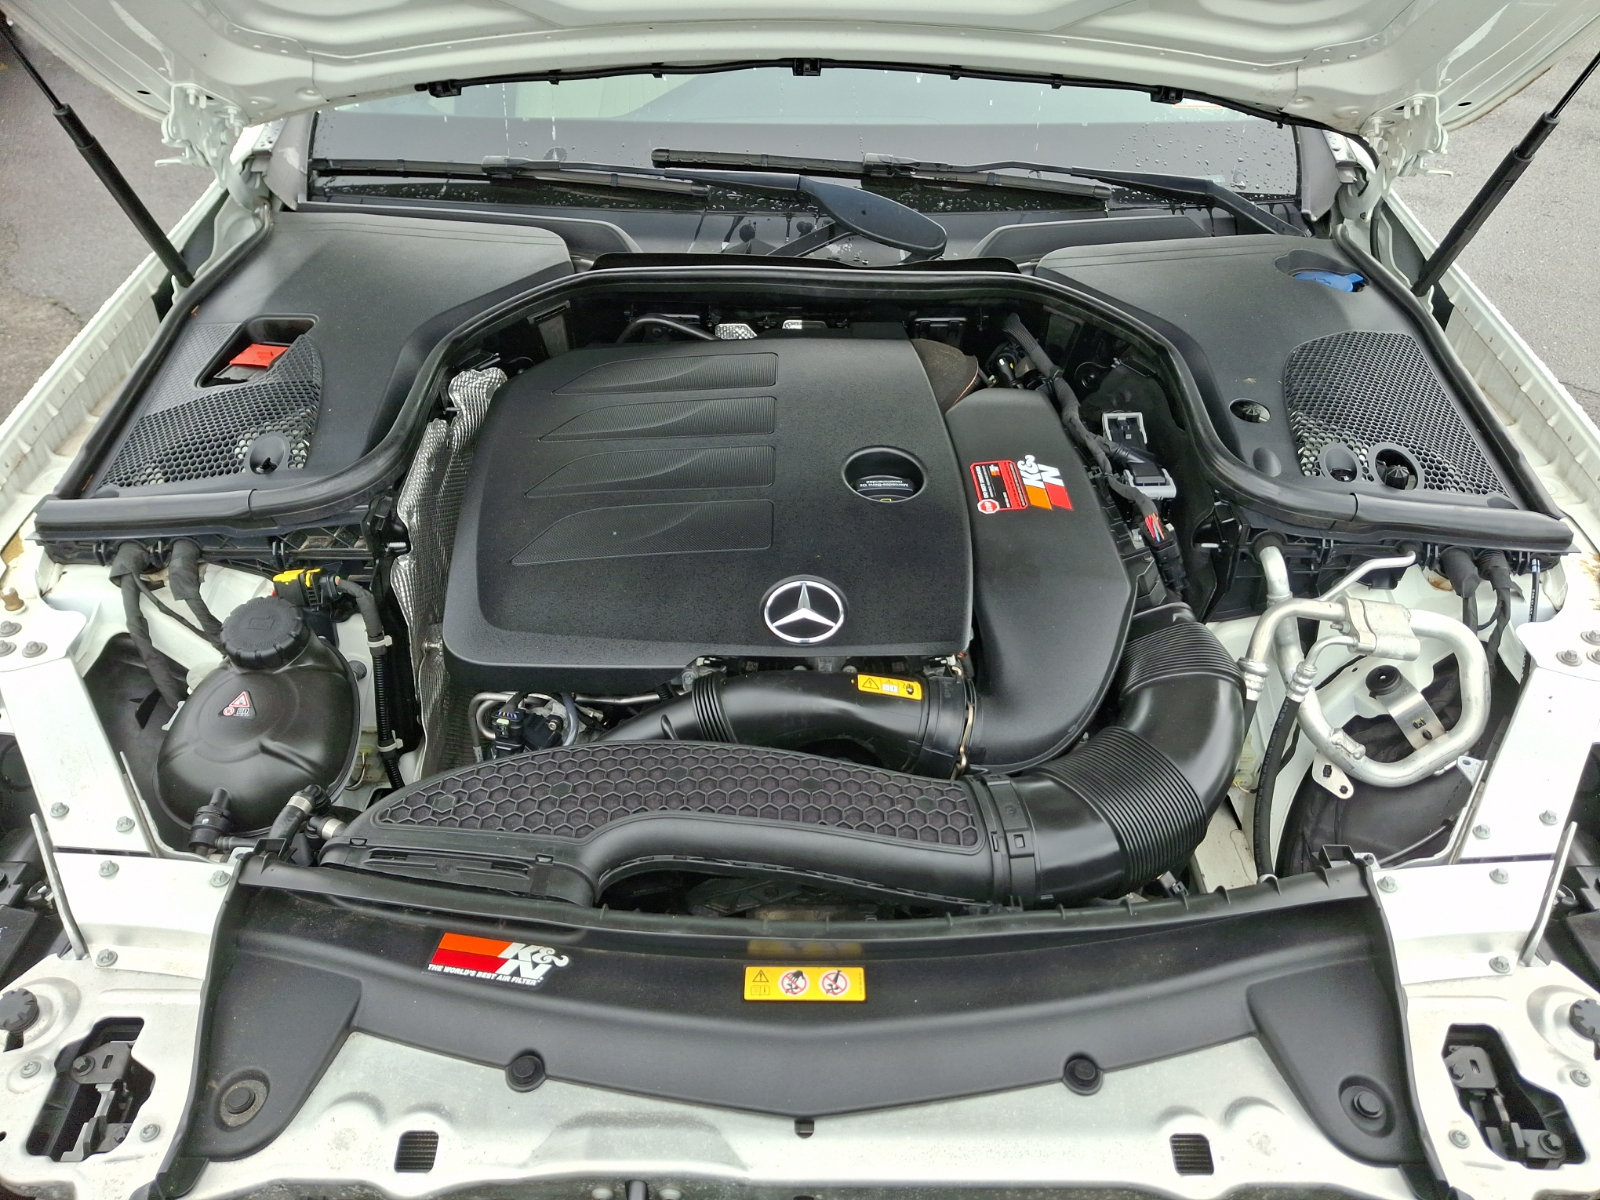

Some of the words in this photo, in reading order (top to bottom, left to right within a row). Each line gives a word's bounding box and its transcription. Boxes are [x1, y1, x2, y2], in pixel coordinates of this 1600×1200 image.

[427, 963, 444, 972] THE
[444, 966, 476, 976] WORLD'S
[476, 971, 497, 980] BEST
[497, 974, 510, 982] AIR
[511, 976, 537, 986] FILTER
